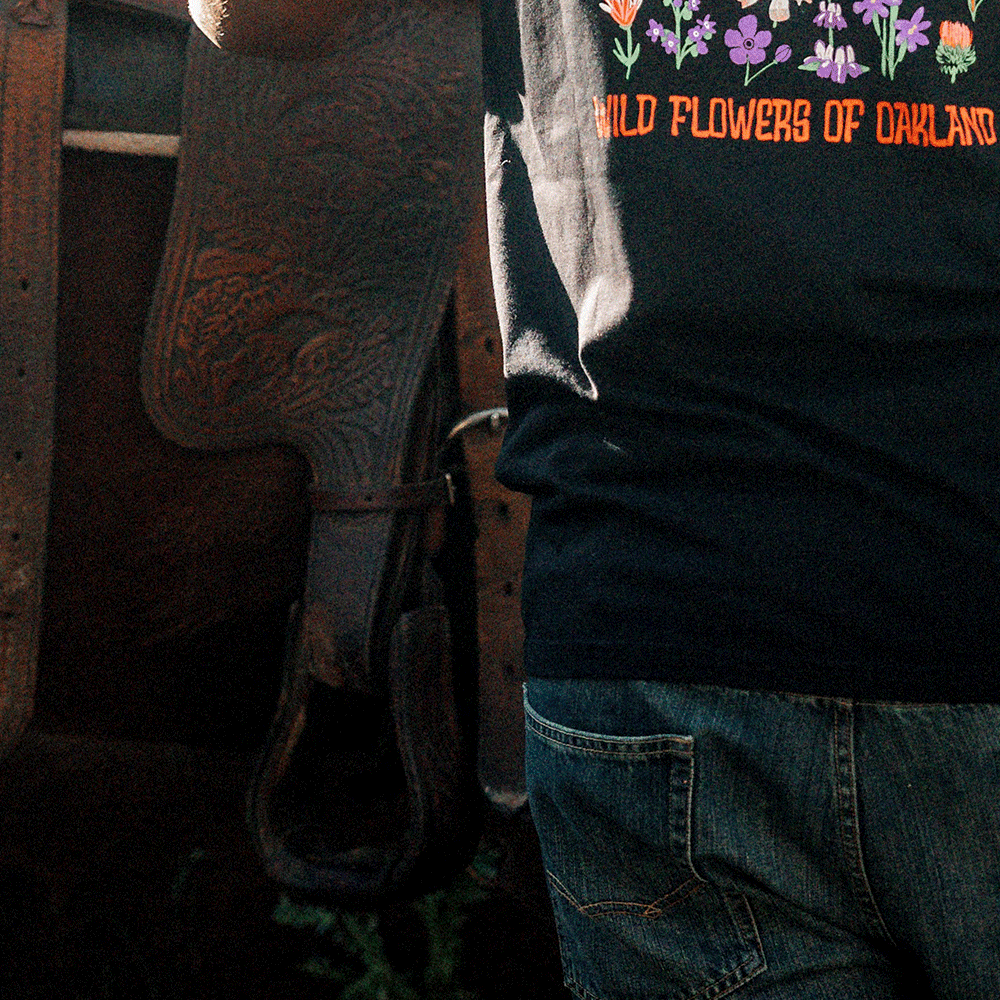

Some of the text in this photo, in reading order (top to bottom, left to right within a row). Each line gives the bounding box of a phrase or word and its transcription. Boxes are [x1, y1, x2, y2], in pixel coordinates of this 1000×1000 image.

[592, 94, 998, 147] WILD FLOWERS OF OAKLAND
